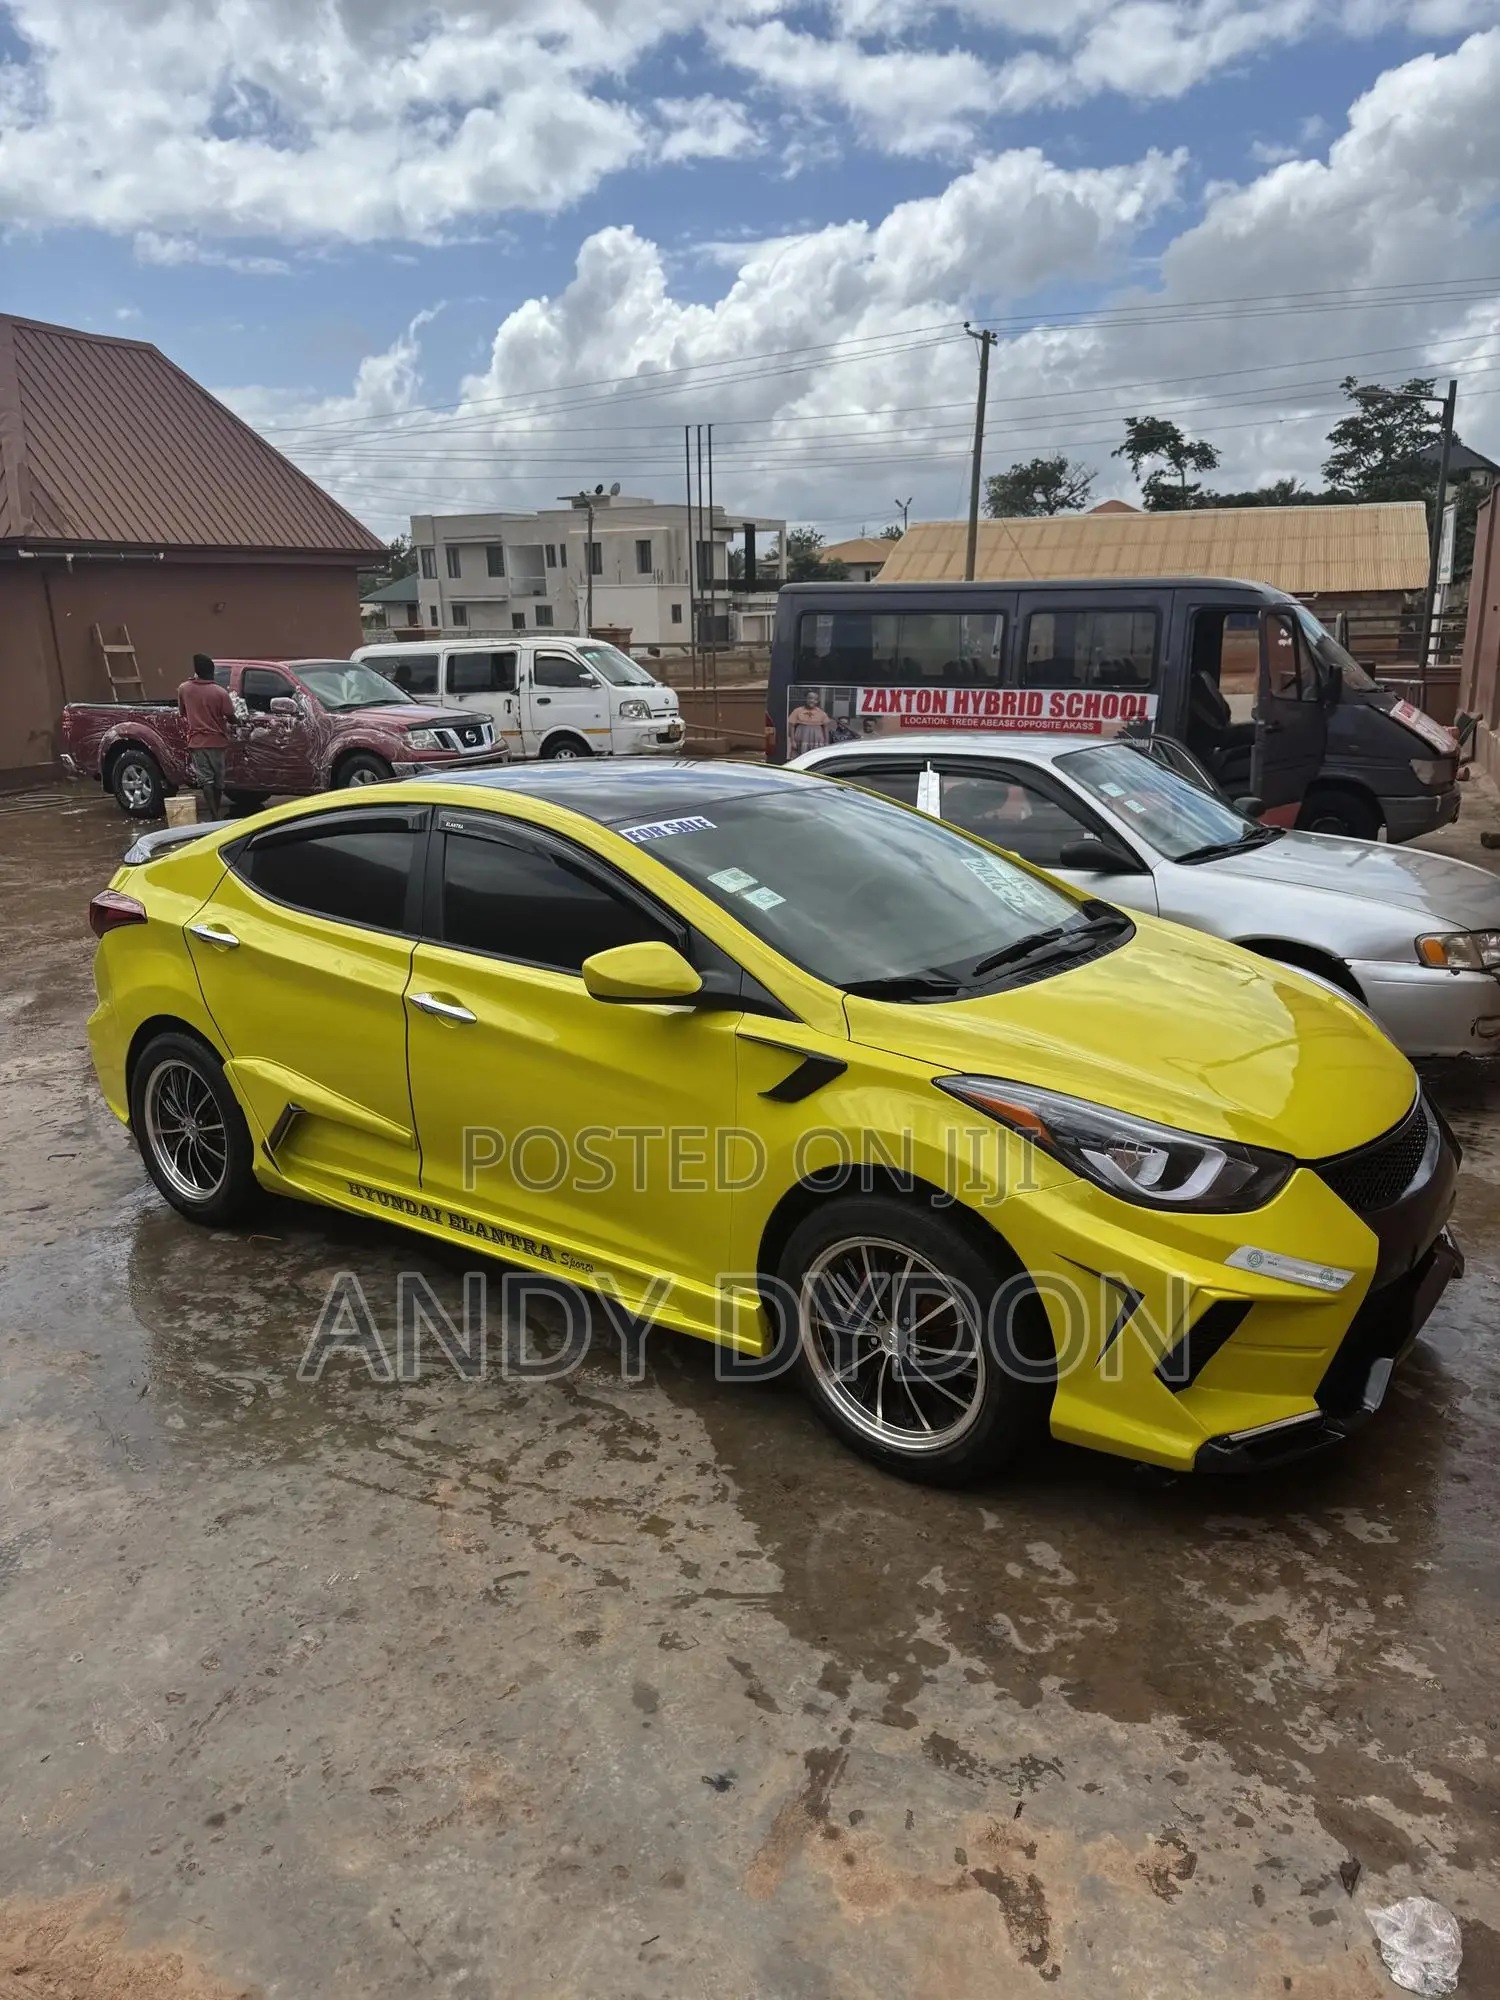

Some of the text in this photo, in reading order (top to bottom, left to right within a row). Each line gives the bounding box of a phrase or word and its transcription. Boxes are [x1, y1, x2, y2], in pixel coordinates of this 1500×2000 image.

[861, 688, 1149, 721] ZAXTON HYBRID SCHOOL
[905, 717, 1095, 730] LOCATION: TREDE ABEASE OPPOSITE AKASS
[624, 817, 711, 842] FOR SALE
[347, 1181, 595, 1273] HYUNDAI ELANTRA Sports
